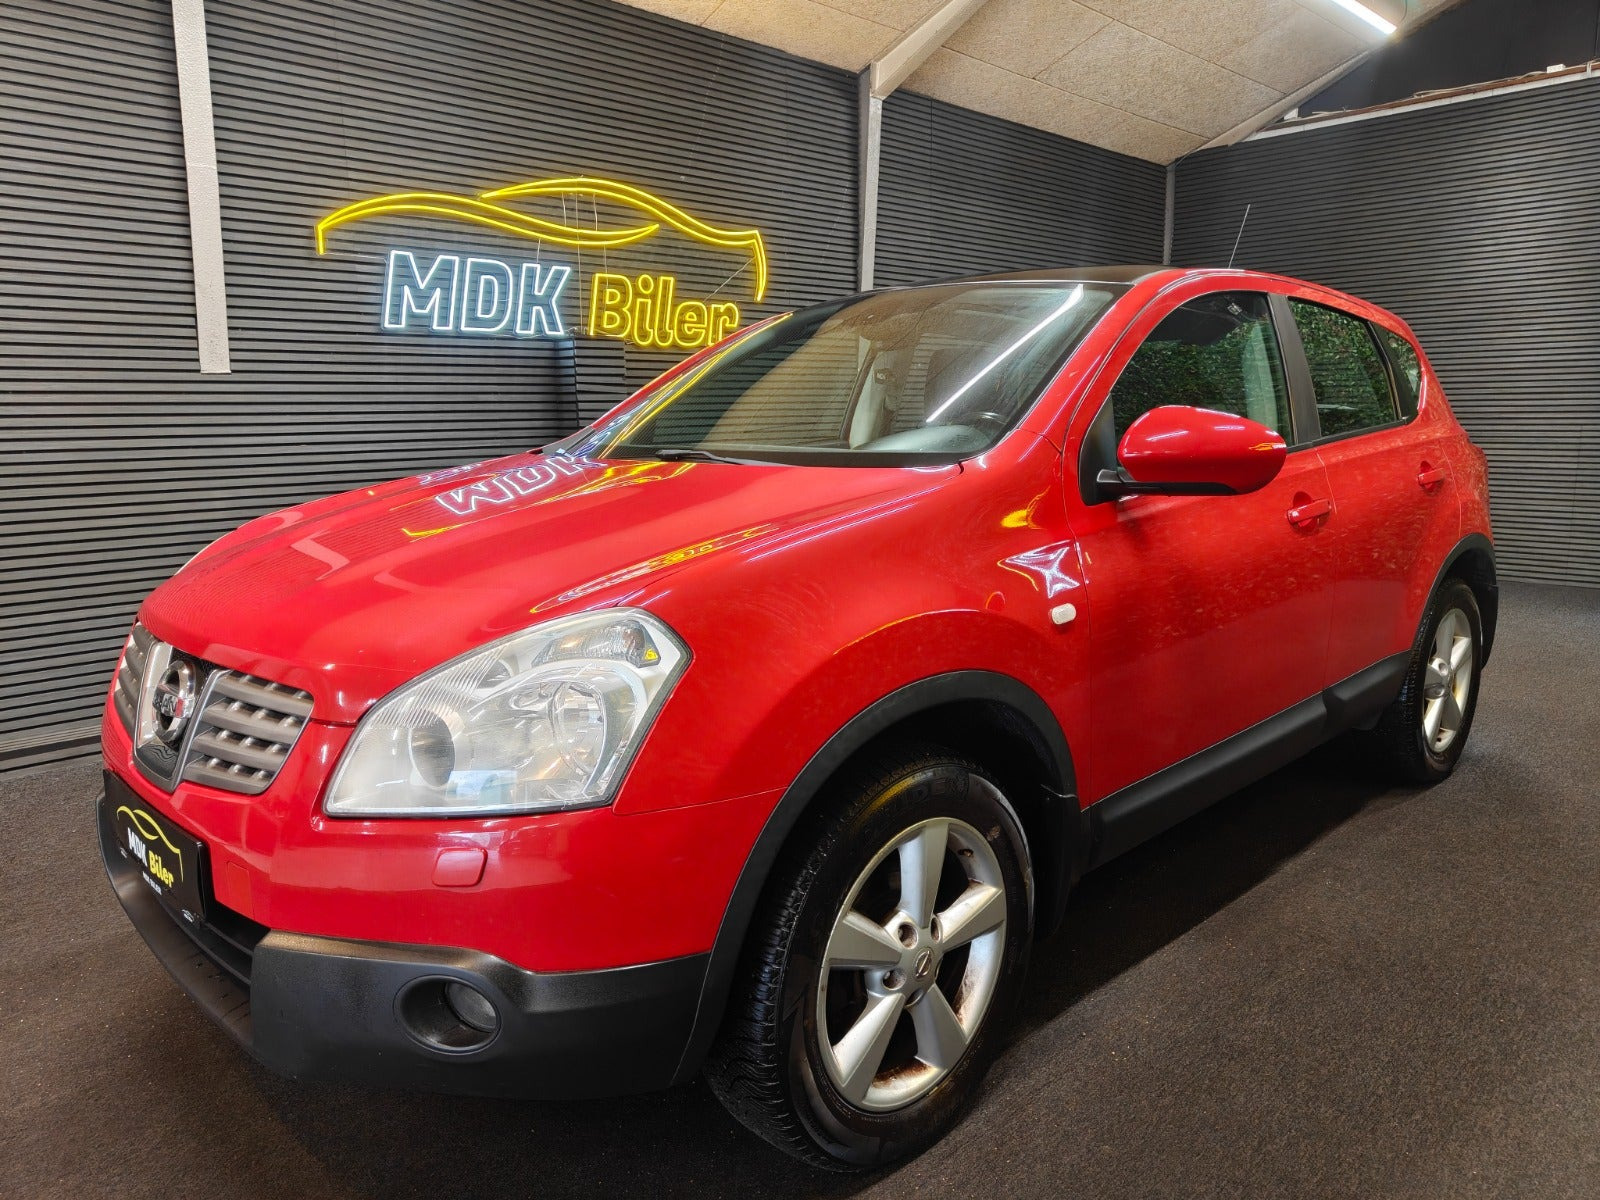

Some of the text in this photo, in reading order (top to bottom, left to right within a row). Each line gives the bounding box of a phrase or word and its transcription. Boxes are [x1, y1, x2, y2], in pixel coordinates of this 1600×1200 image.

[382, 249, 739, 348] MDK Biler
[127, 826, 148, 867] MDK
[149, 850, 174, 889] Biler
